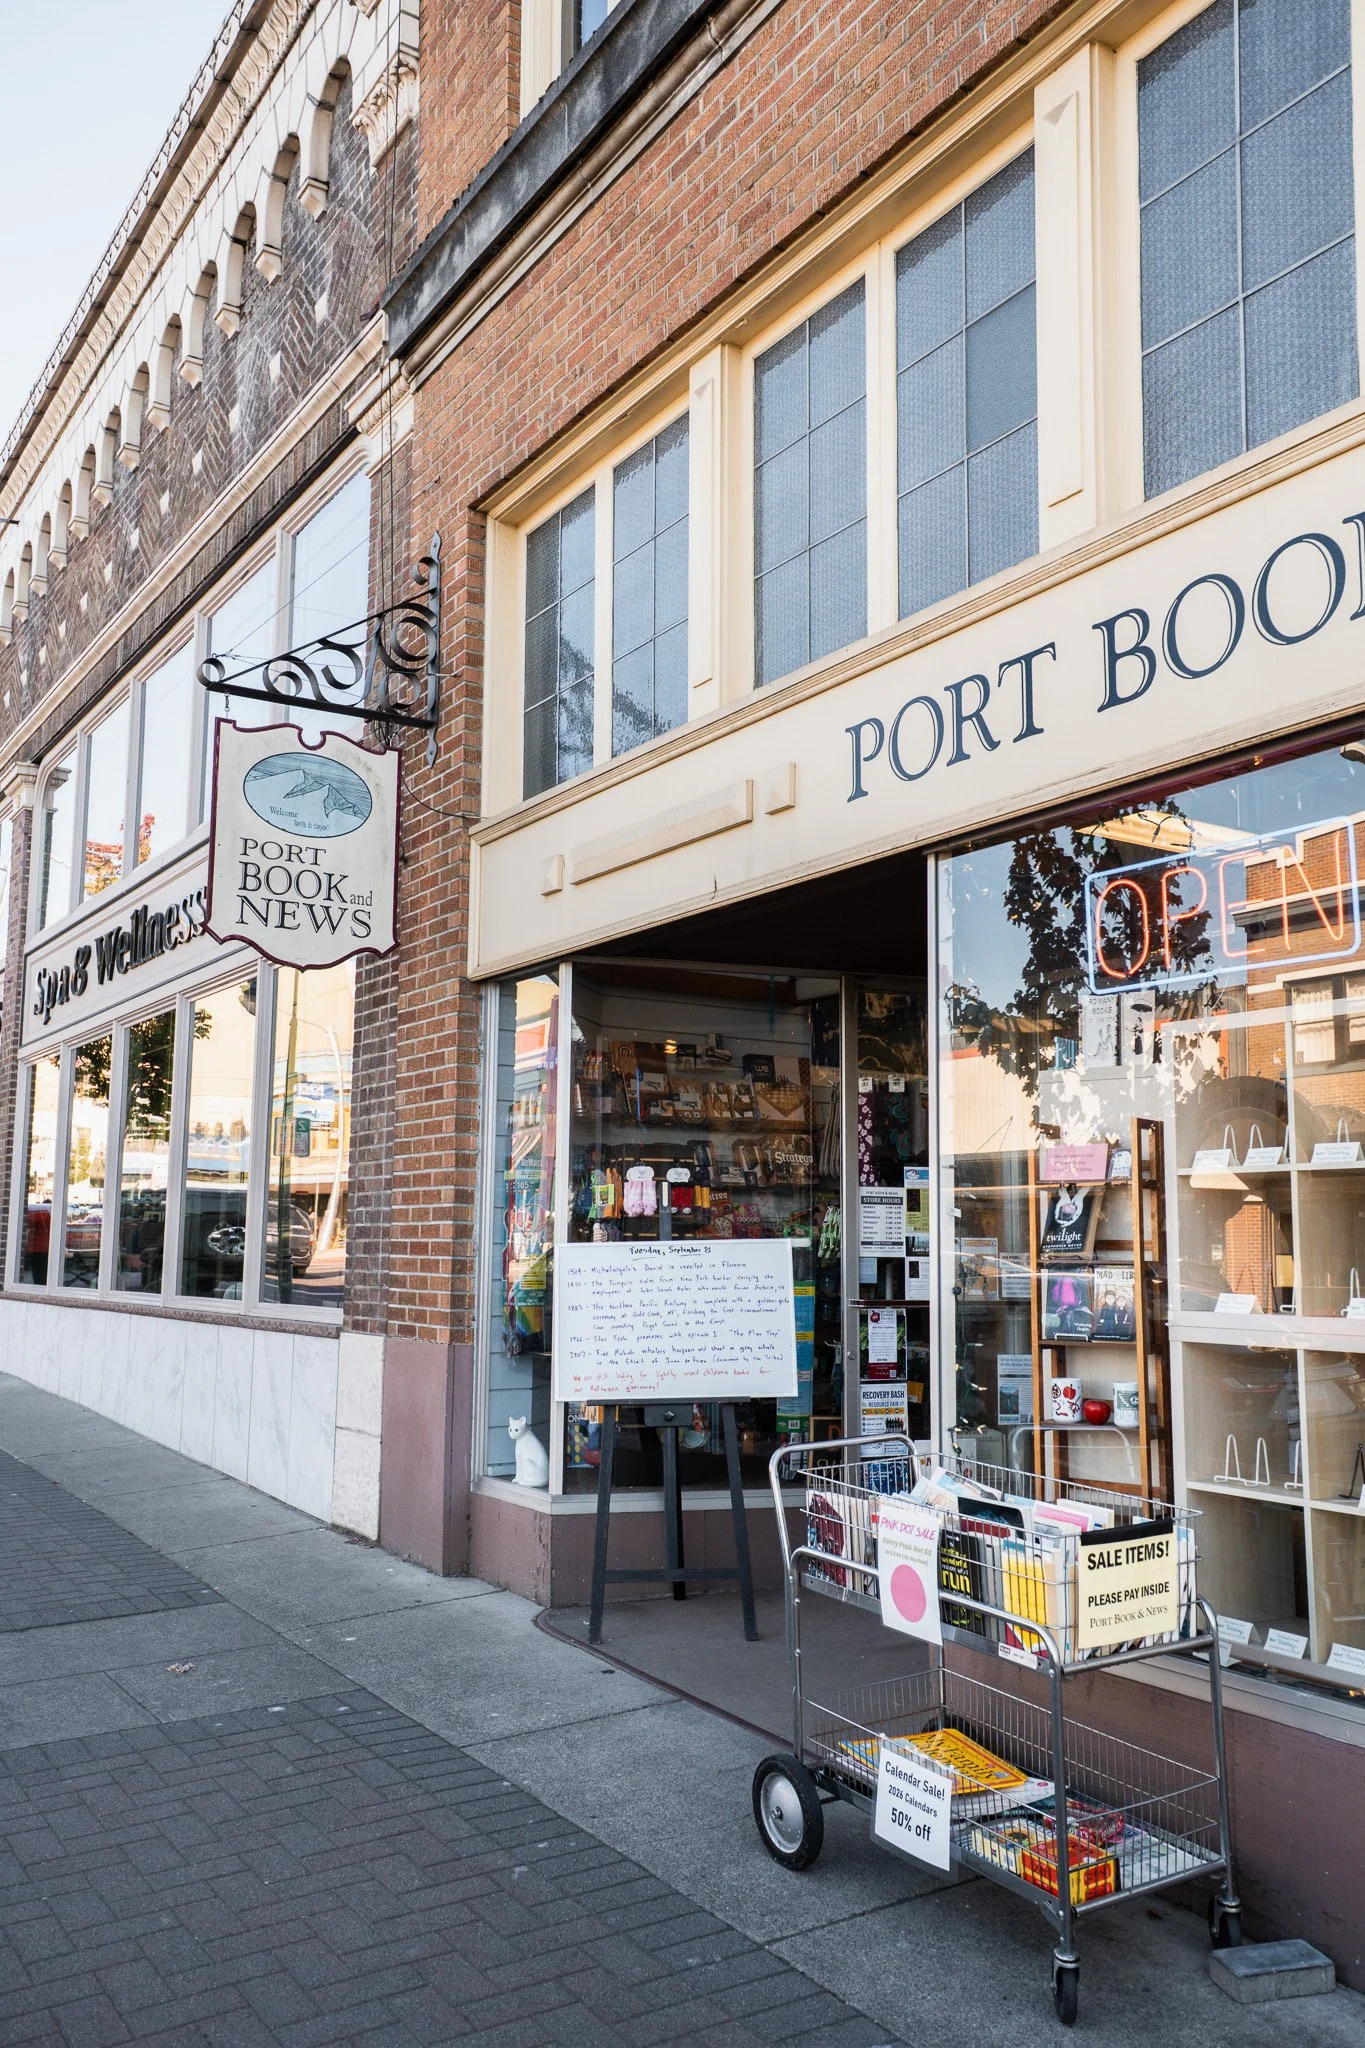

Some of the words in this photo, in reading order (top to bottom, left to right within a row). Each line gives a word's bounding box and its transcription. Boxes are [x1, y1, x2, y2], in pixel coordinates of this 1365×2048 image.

[844, 641, 1057, 803] PORT
[1091, 512, 1365, 713] BOO
[269, 806, 299, 818] Welcome
[240, 836, 327, 867] PORT
[238, 860, 349, 904] BOOK
[350, 890, 373, 907] and
[1093, 830, 1345, 979] OPEN
[236, 894, 372, 939] NEWS
[33, 965, 70, 1025] Spa
[94, 885, 208, 985] Wellness
[774, 1151, 814, 1166] Stratego
[1046, 1227, 1082, 1243] twilight
[629, 1246, 666, 1256] Tuesday,
[668, 1245, 701, 1254] September
[644, 1263, 663, 1271] David
[1096, 1270, 1113, 1280] MAD
[592, 1302, 604, 1310] The
[633, 1310, 645, 1318] Gold
[593, 1334, 607, 1342] Star
[641, 1346, 666, 1354] whalers
[625, 1357, 644, 1365] Strait
[733, 1368, 750, 1376] books
[758, 1366, 771, 1374] for
[590, 1384, 619, 1393] Halloween
[862, 1390, 890, 1400] RECOVERY
[890, 1390, 905, 1399] BASH
[880, 1517, 898, 1532] PINK
[900, 1521, 915, 1536] DOT
[915, 1527, 937, 1541] SALE
[883, 1538, 898, 1548] Every
[899, 1541, 912, 1550] Pink
[912, 1544, 923, 1553] Dot
[1087, 1549, 1122, 1571] SALE
[1125, 1540, 1169, 1565] ITEMS!
[942, 1570, 971, 1594] run
[1088, 1591, 1122, 1608] PLEASE
[1124, 1587, 1140, 1601] PAY
[1141, 1581, 1170, 1598] INSIDE
[1089, 1617, 1113, 1629] PORT
[1114, 1611, 1137, 1625] BOOK
[1137, 1609, 1144, 1619] &
[1145, 1605, 1168, 1617] NEWS
[885, 1761, 921, 1788] Calendar
[922, 1780, 945, 1801] Sale!
[888, 1784, 904, 1800] 2026
[904, 1792, 938, 1818] Calendars
[891, 1807, 912, 1832] 50%
[915, 1824, 931, 1842] off
